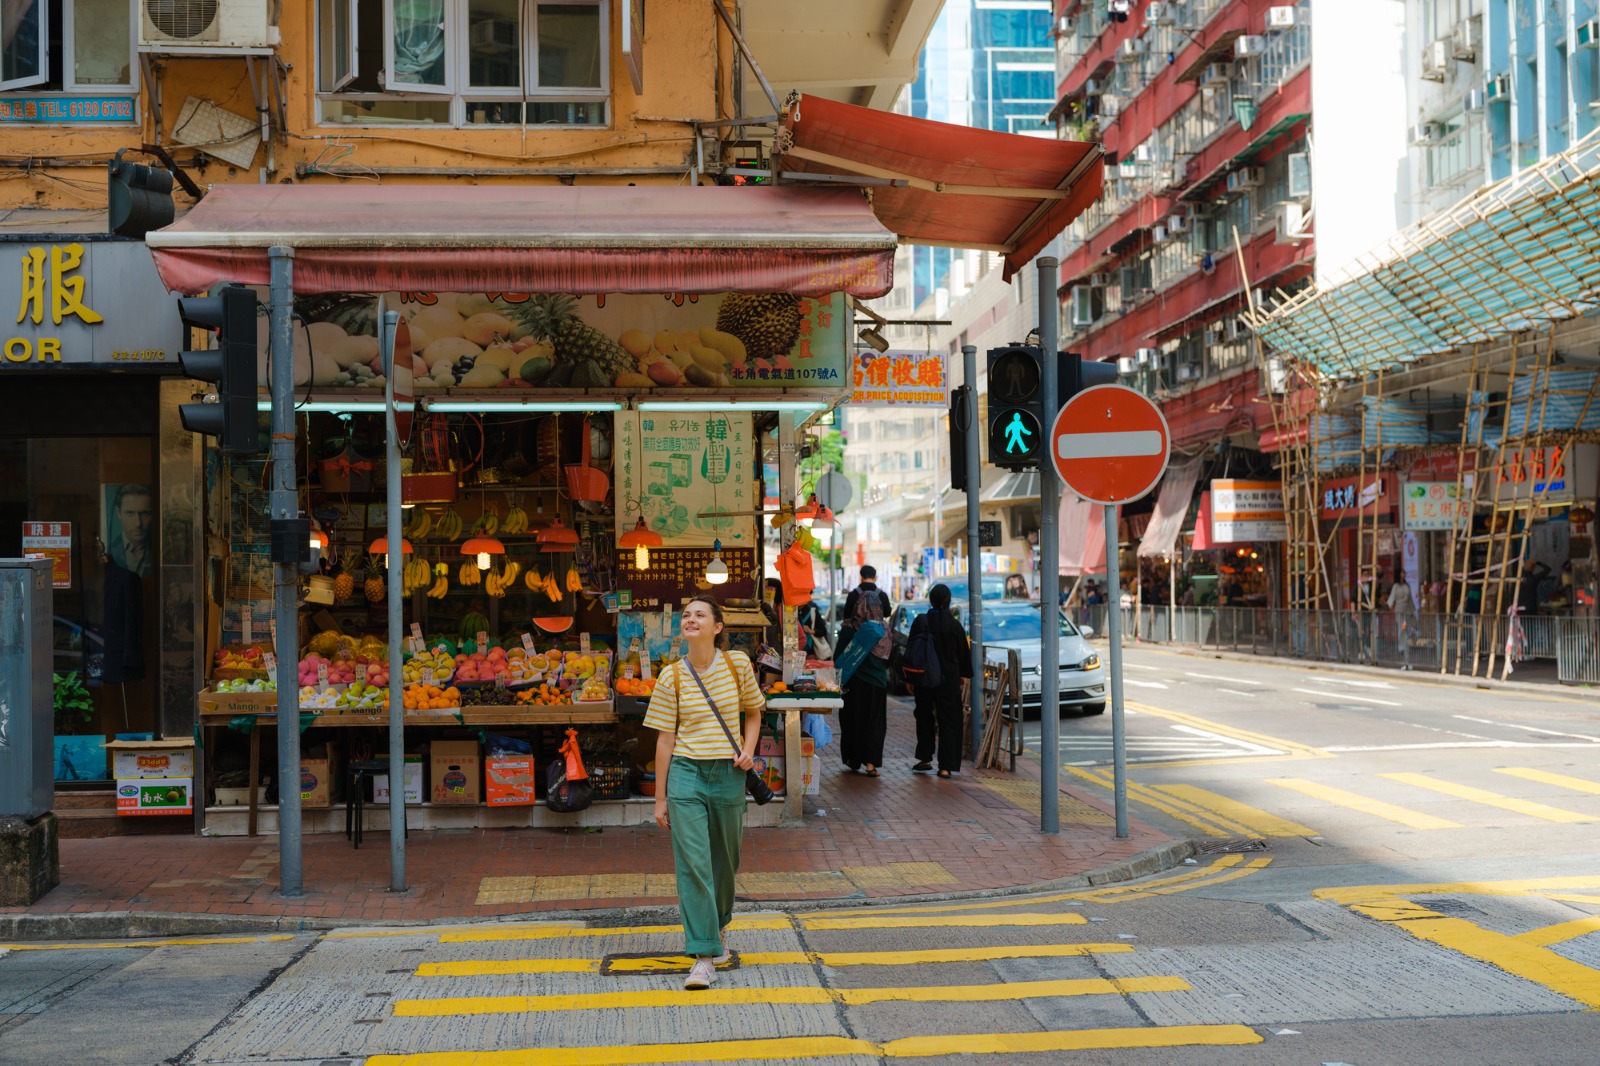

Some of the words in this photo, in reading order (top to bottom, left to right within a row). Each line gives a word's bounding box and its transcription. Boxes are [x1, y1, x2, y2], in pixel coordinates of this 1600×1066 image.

[40, 102, 67, 117] TEL:
[69, 102, 98, 116] 6120
[101, 102, 131, 115] 6702
[16, 242, 104, 325] 服
[0, 337, 62, 362] OR
[733, 368, 838, 379] 北角電氣道107號A
[866, 391, 893, 401] PRICE
[894, 392, 944, 402] ACQUISITION
[669, 420, 701, 431] 유기농
[706, 419, 727, 440] 韓
[31, 524, 62, 536] 快捷
[228, 703, 259, 712] Mango
[142, 791, 164, 803] 南水
